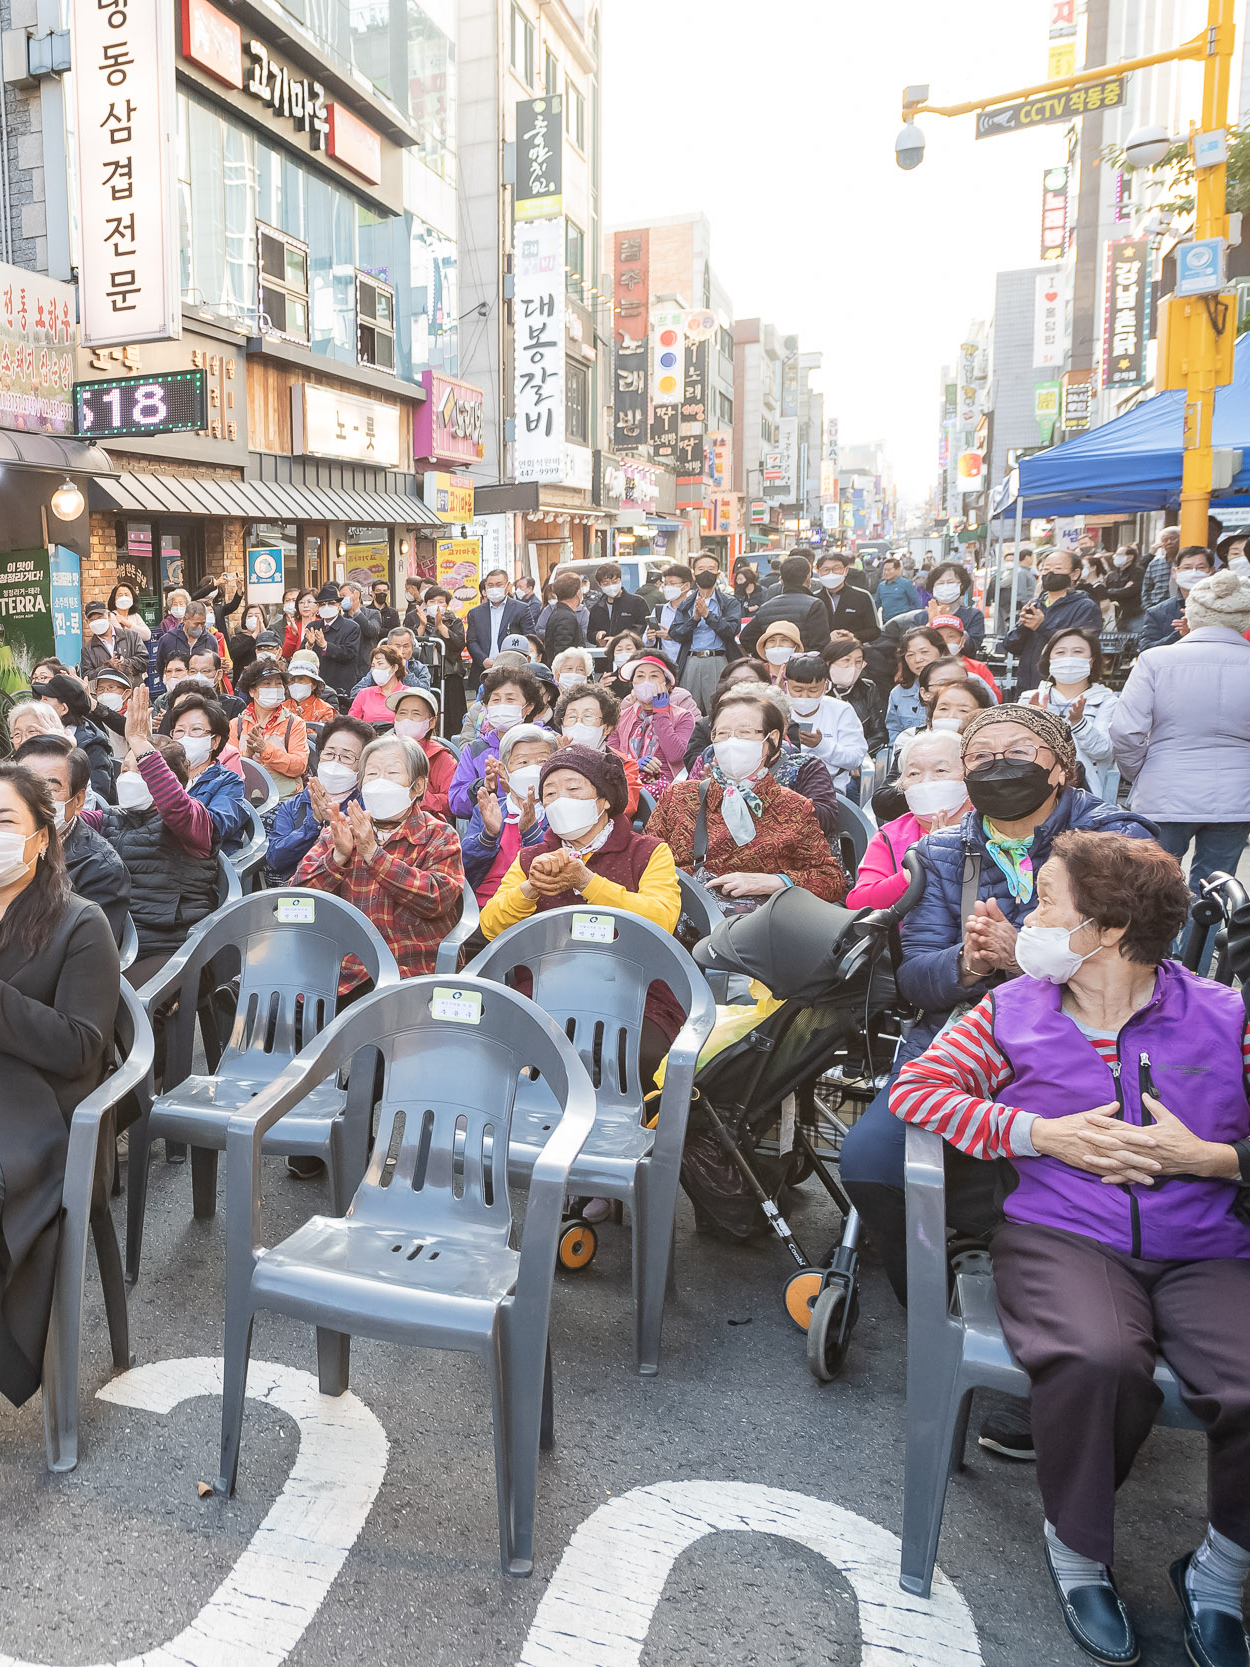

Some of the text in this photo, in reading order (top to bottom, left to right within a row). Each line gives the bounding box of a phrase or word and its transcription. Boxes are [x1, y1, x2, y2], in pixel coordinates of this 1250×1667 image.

[1019, 82, 1121, 124] CCTV 작동중
[35, 297, 71, 343] 노하우
[520, 293, 559, 437] 대봉갈비
[616, 329, 645, 436] 노래방
[519, 467, 560, 477] 447-9999
[0, 570, 44, 584] 청정라거다!
[6, 560, 35, 573] 이 맛이
[54, 612, 81, 636] 진-로
